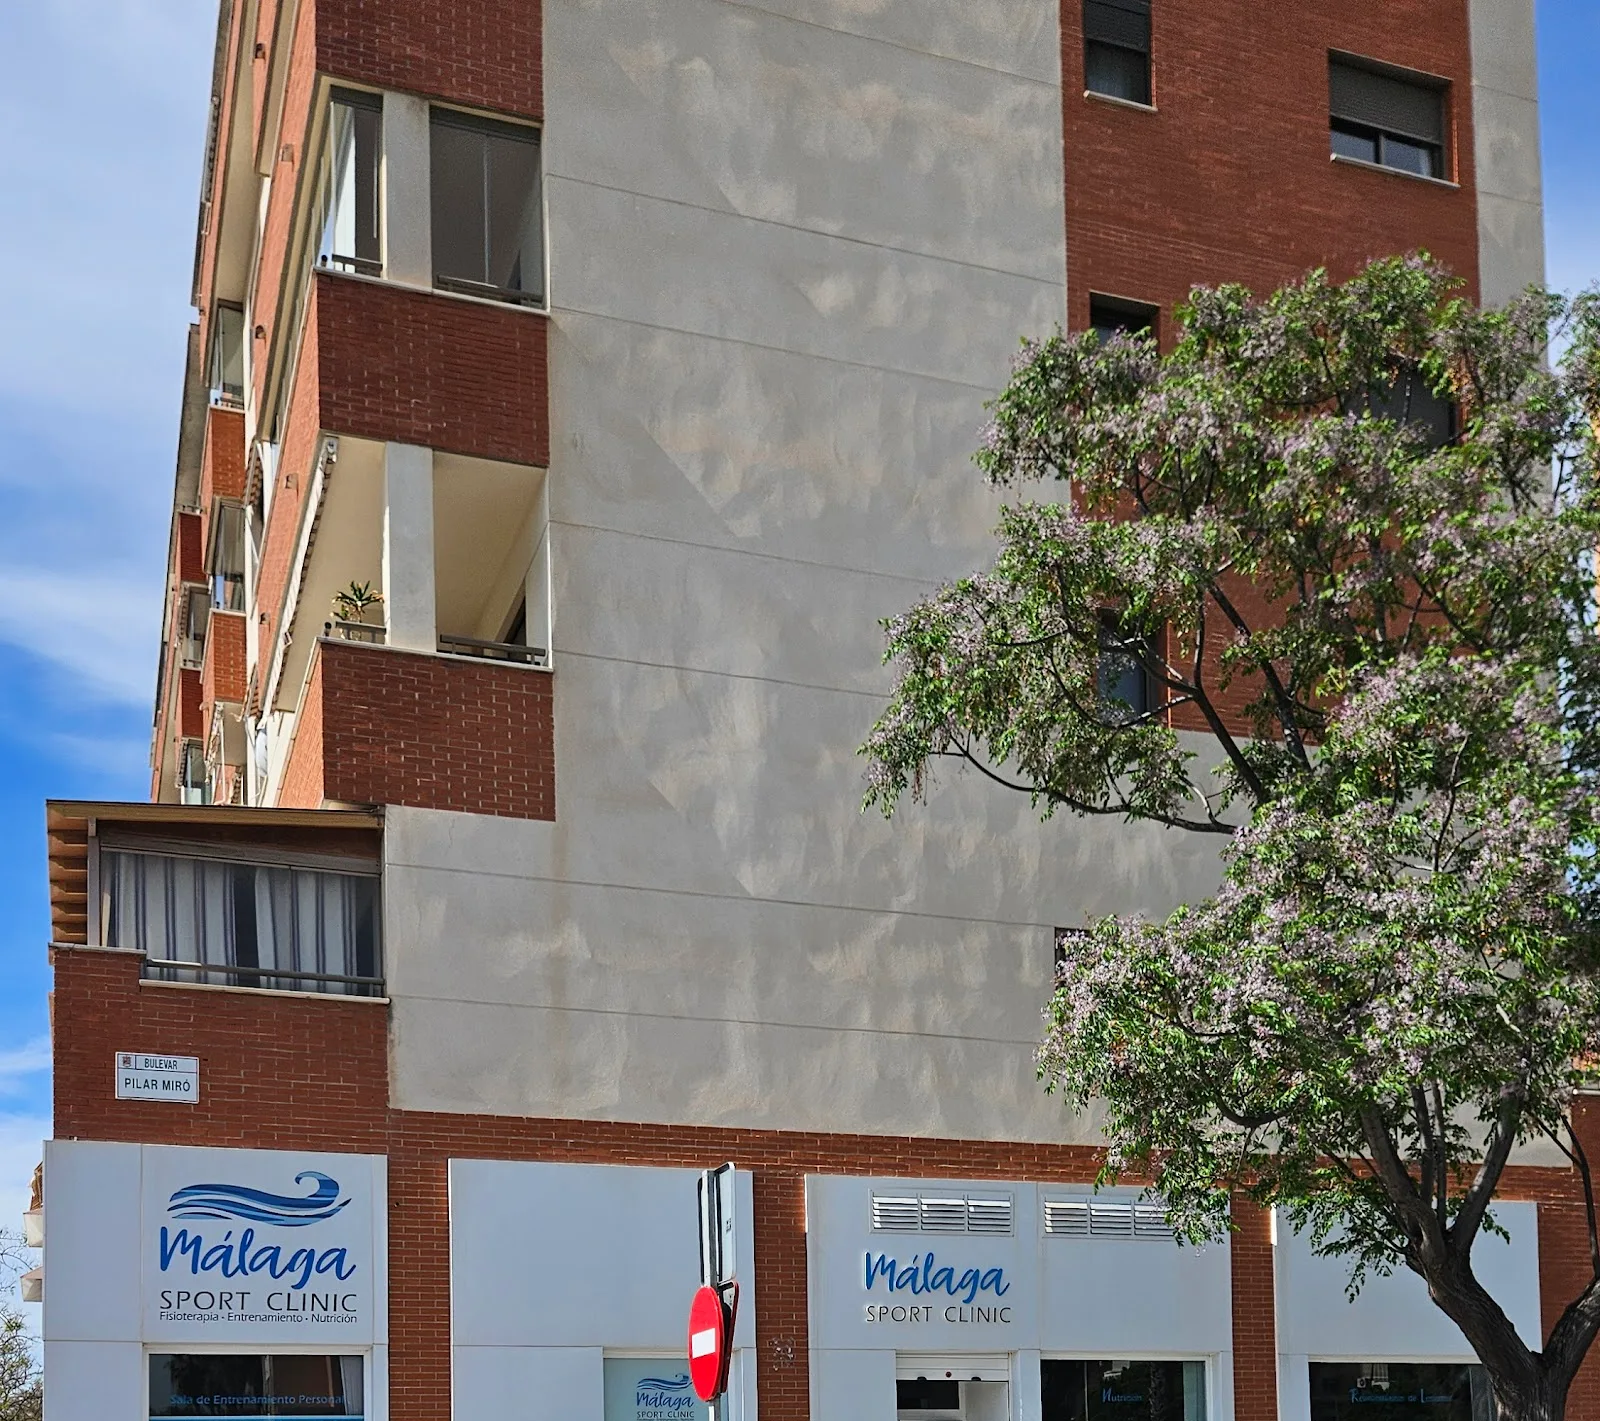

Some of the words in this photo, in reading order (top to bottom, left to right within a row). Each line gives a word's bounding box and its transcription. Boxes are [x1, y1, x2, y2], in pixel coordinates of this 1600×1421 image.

[144, 1058, 178, 1070] BULEVAR
[124, 1078, 158, 1090] PILAR
[162, 1079, 191, 1092] MIRÓ
[160, 1226, 357, 1290] Málaga
[865, 1251, 1011, 1304] Málaga
[160, 1290, 251, 1311] SPORT
[266, 1292, 357, 1312] CLINIC
[159, 1311, 219, 1323] Fisioterapia
[227, 1313, 304, 1323] Entrenamiento
[311, 1313, 357, 1324] Nutrición
[866, 1305, 933, 1322] SPORT
[944, 1306, 1011, 1323] CLINIC
[170, 1394, 193, 1405] Sala
[196, 1394, 211, 1405] de
[213, 1394, 296, 1405] Entrenamiento
[298, 1394, 345, 1405] Personal
[636, 1391, 694, 1411] Málaga
